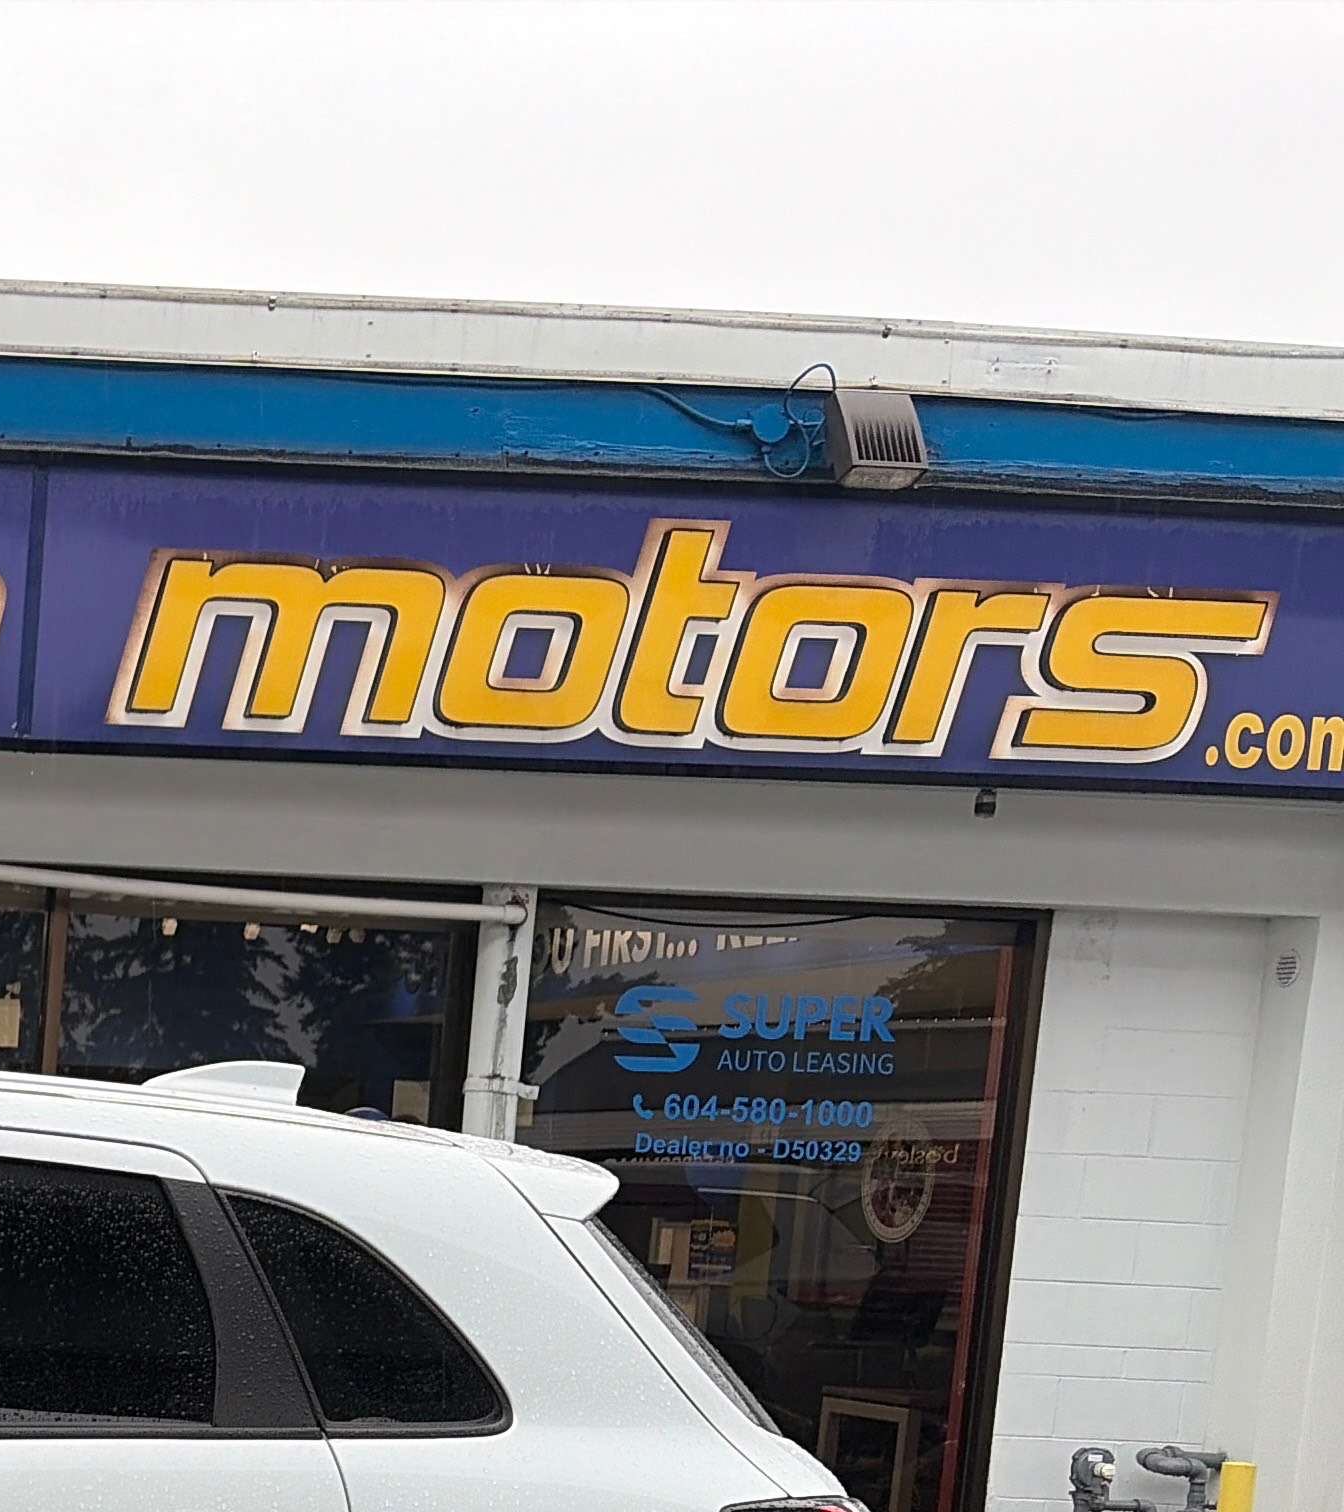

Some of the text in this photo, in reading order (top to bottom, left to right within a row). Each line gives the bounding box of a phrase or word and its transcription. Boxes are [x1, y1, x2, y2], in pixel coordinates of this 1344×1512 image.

[114, 522, 1276, 758] motors
[718, 991, 897, 1042] SUPER
[716, 1049, 895, 1076] AUTO LEASING
[663, 1093, 874, 1128] 604-580-1000
[634, 1131, 713, 1157] Dealer
[719, 1140, 750, 1158] no
[772, 1138, 862, 1163] D50329
